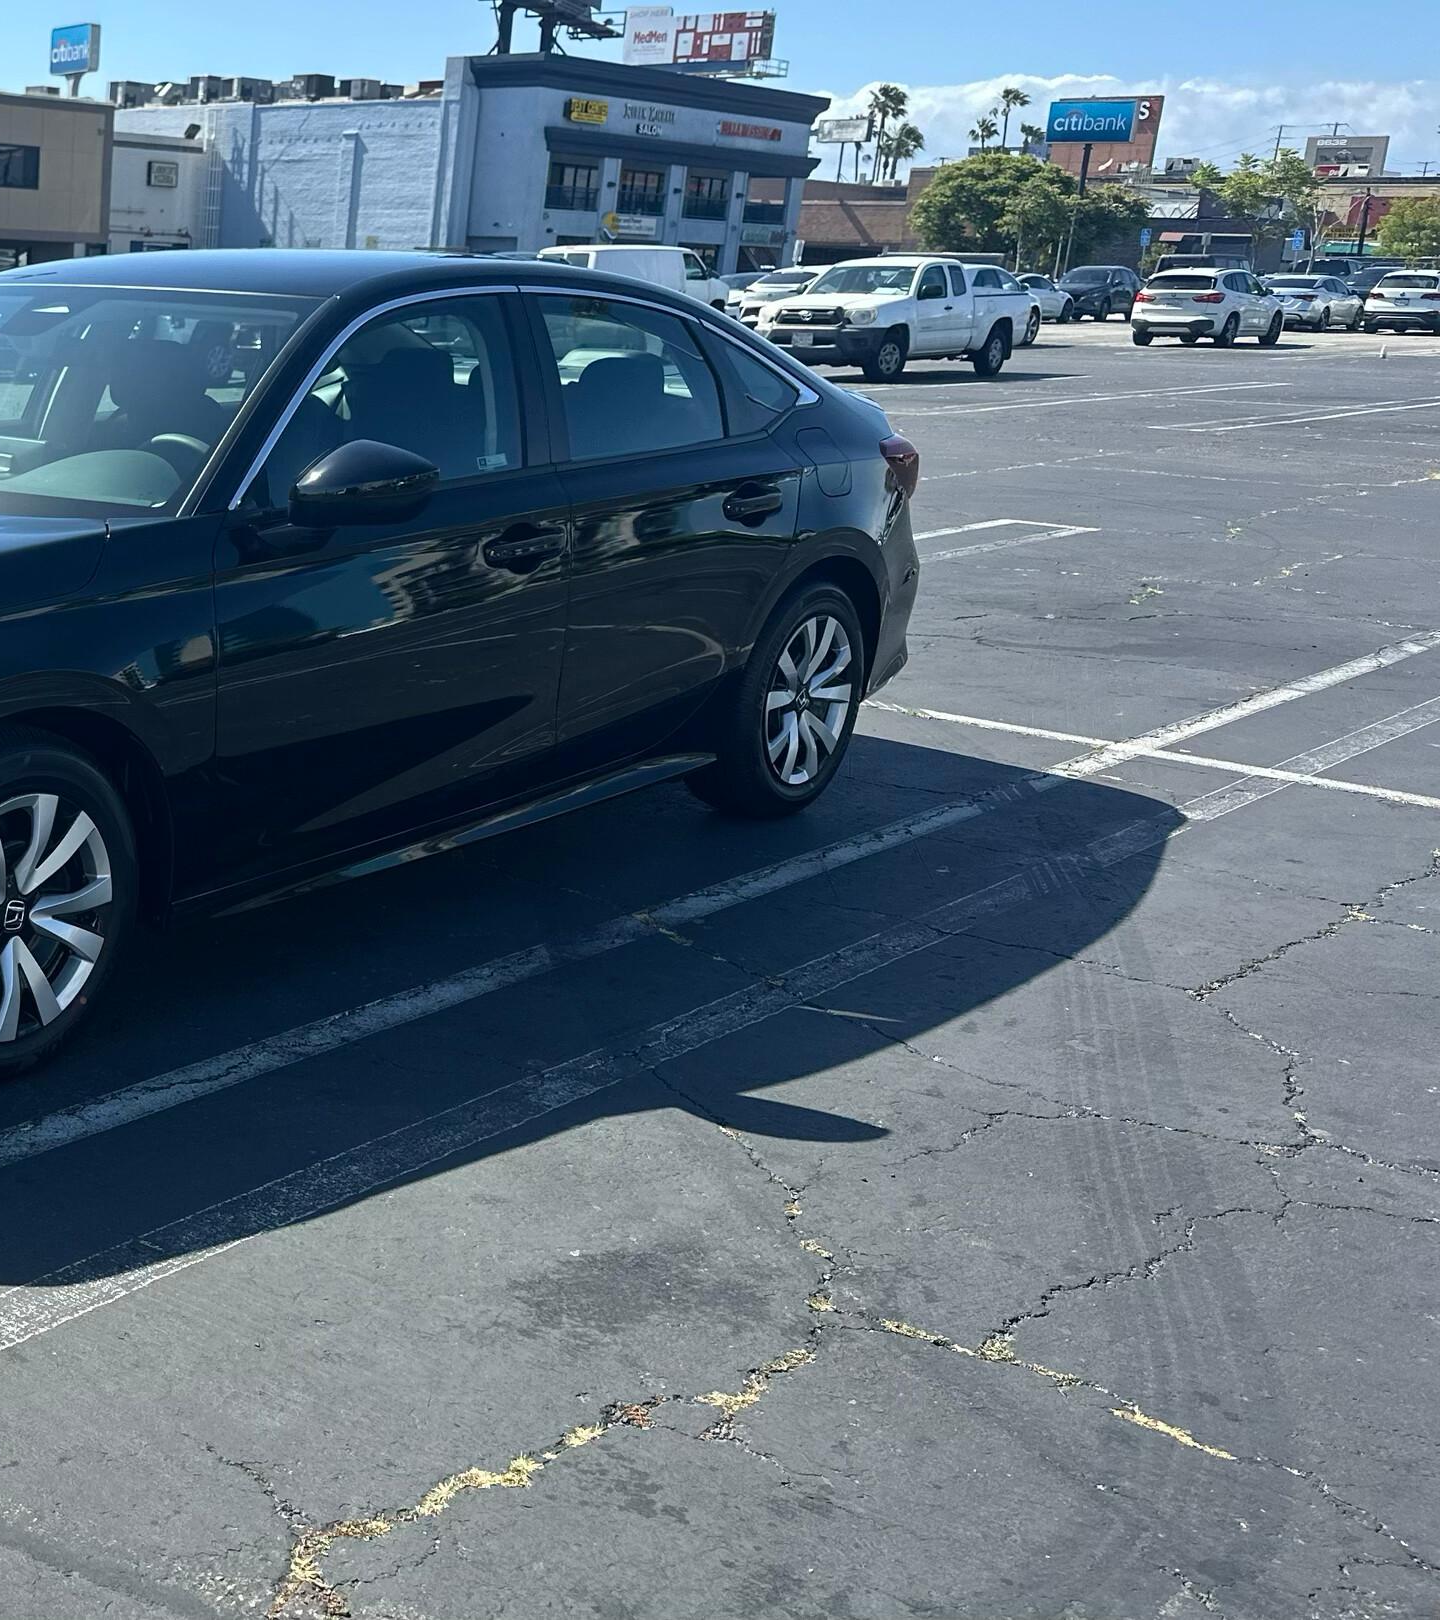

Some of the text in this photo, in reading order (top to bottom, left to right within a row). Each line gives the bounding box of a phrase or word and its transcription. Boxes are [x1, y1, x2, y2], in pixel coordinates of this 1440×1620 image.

[633, 31, 668, 44] MedMen
[52, 41, 88, 63] citibank
[1053, 112, 1127, 131] citibank
